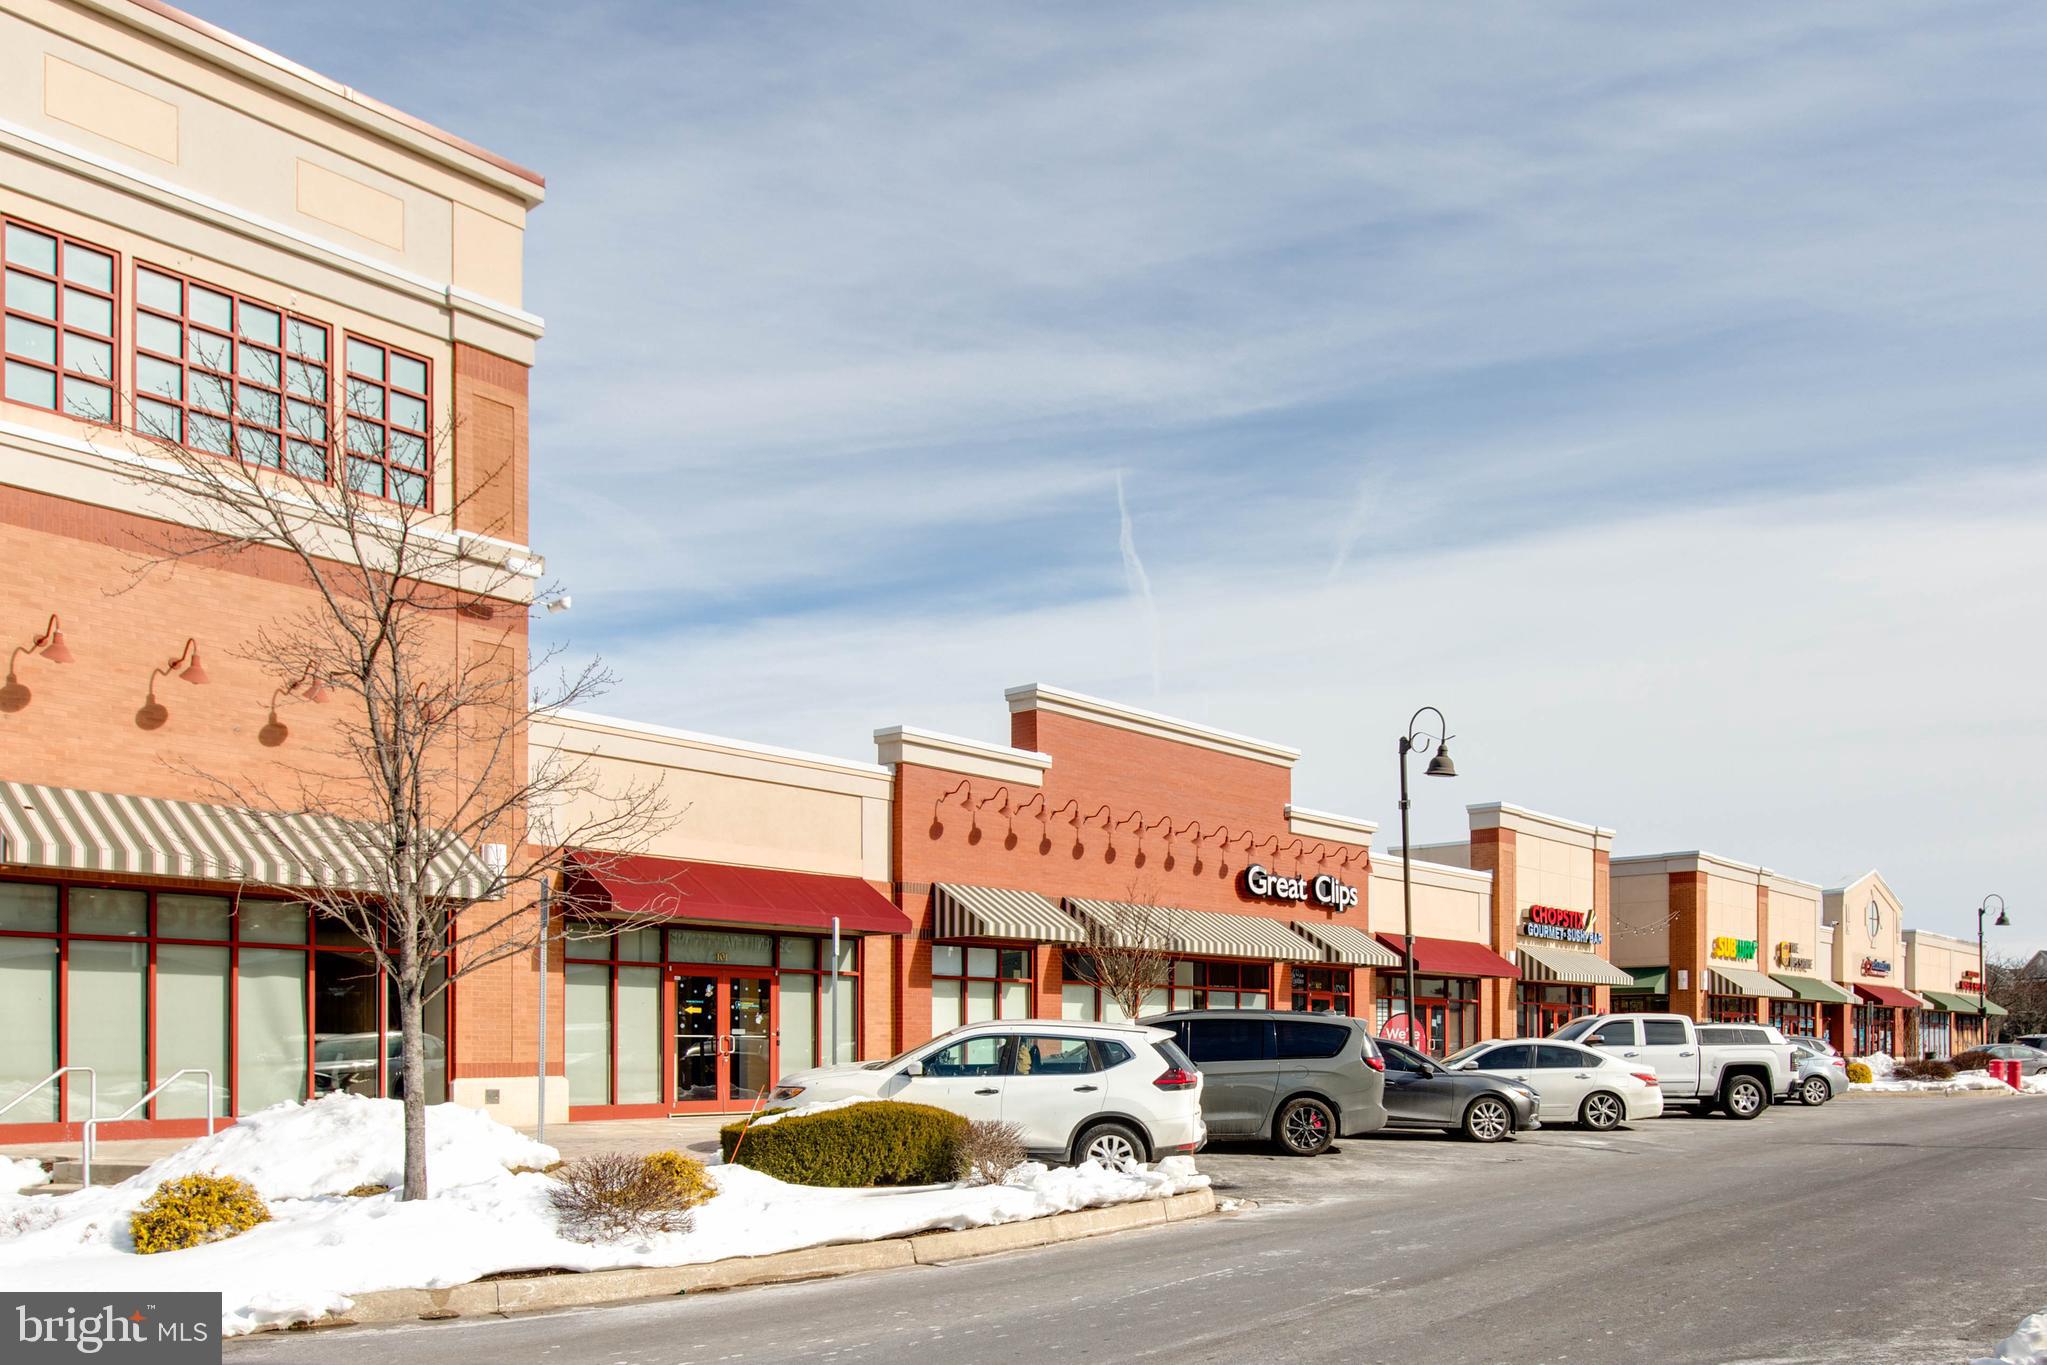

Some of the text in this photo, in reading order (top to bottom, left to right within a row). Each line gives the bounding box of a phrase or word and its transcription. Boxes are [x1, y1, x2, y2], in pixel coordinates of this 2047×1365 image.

[1248, 865, 1359, 912] Great Clips
[1532, 905, 1585, 929] CHOPSTIX
[1717, 936, 1756, 960] SUBWAY
[1386, 1027, 1421, 1040] We'e
